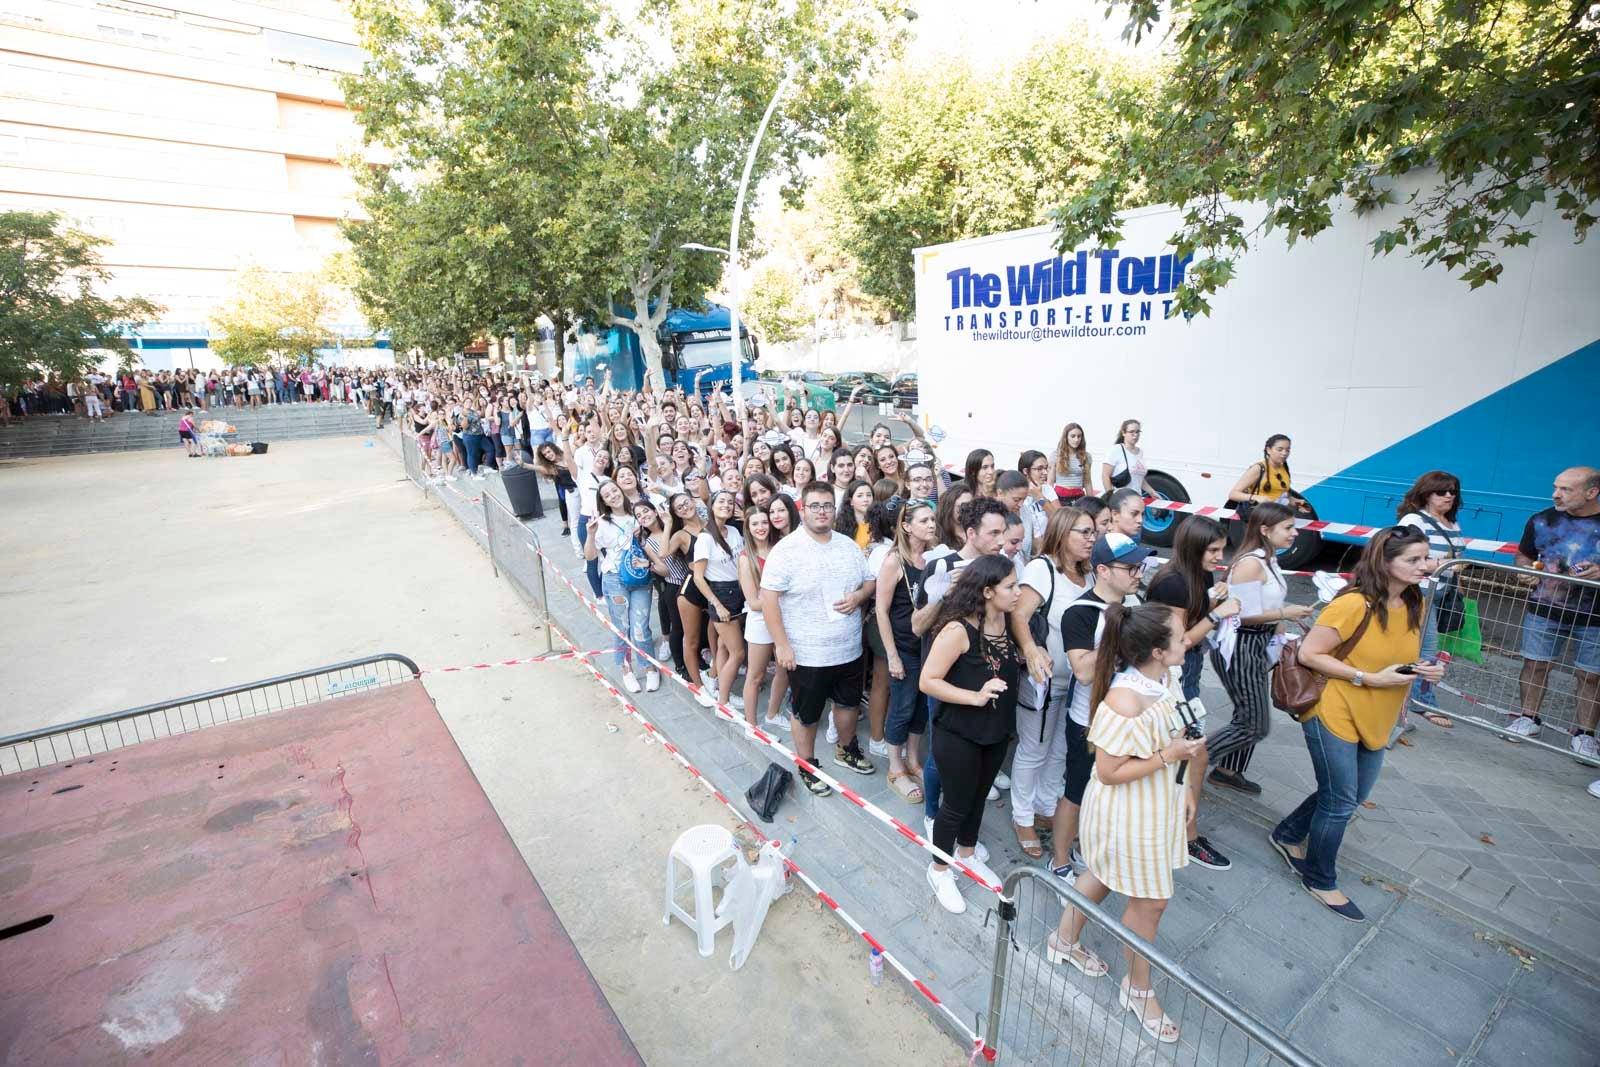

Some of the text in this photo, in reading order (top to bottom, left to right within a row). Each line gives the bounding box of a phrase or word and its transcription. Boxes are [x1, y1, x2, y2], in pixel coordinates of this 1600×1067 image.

[947, 249, 1194, 309] The Wild Tour
[973, 325, 1146, 342] thewildtour@thewildtour.com
